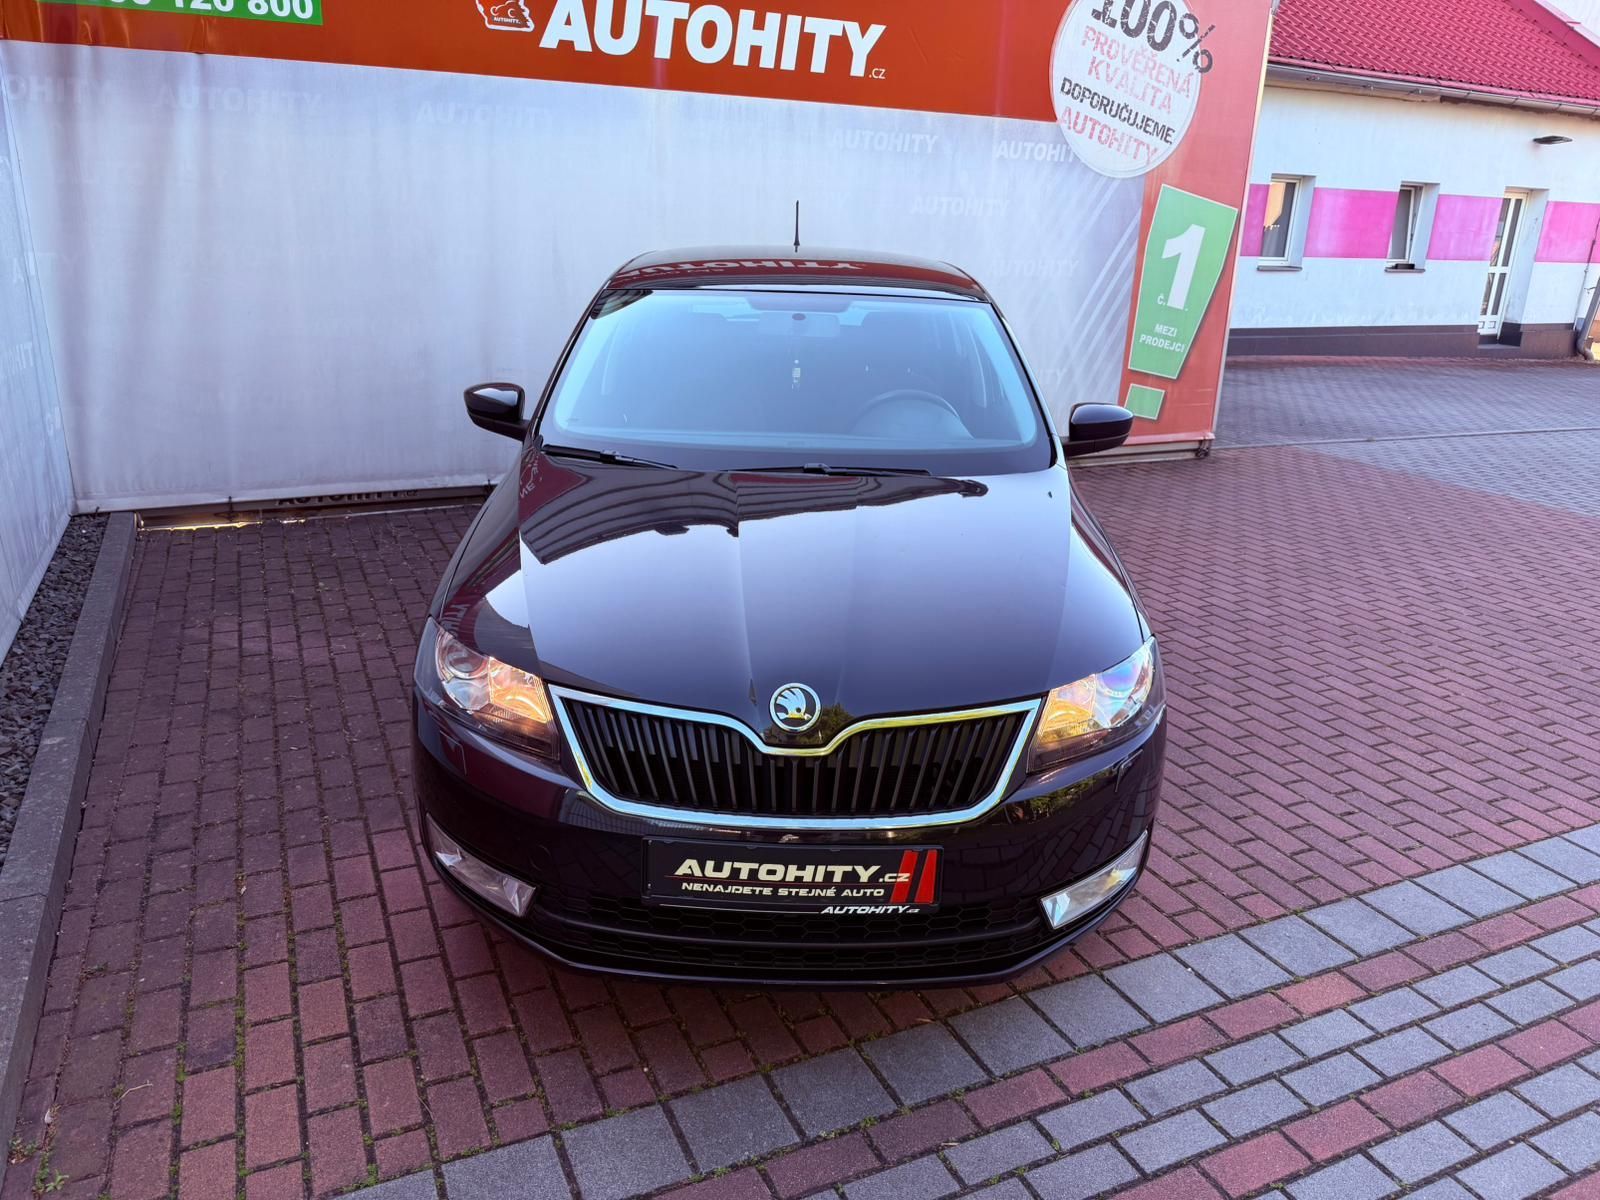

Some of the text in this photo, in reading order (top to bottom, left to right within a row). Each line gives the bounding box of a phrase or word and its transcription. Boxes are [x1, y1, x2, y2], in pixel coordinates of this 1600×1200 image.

[1082, 25, 1194, 98] PROVĚŘENÁ
[1087, 56, 1173, 114] KVALITA
[1058, 106, 1158, 166] AUTOHITY
[1060, 77, 1176, 144] DOPORUČUJEME
[1139, 334, 1185, 352] PRODEJCI
[1154, 323, 1177, 337] MEZI
[681, 882, 885, 897] NENAJDETE STEJNÉ AUTO
